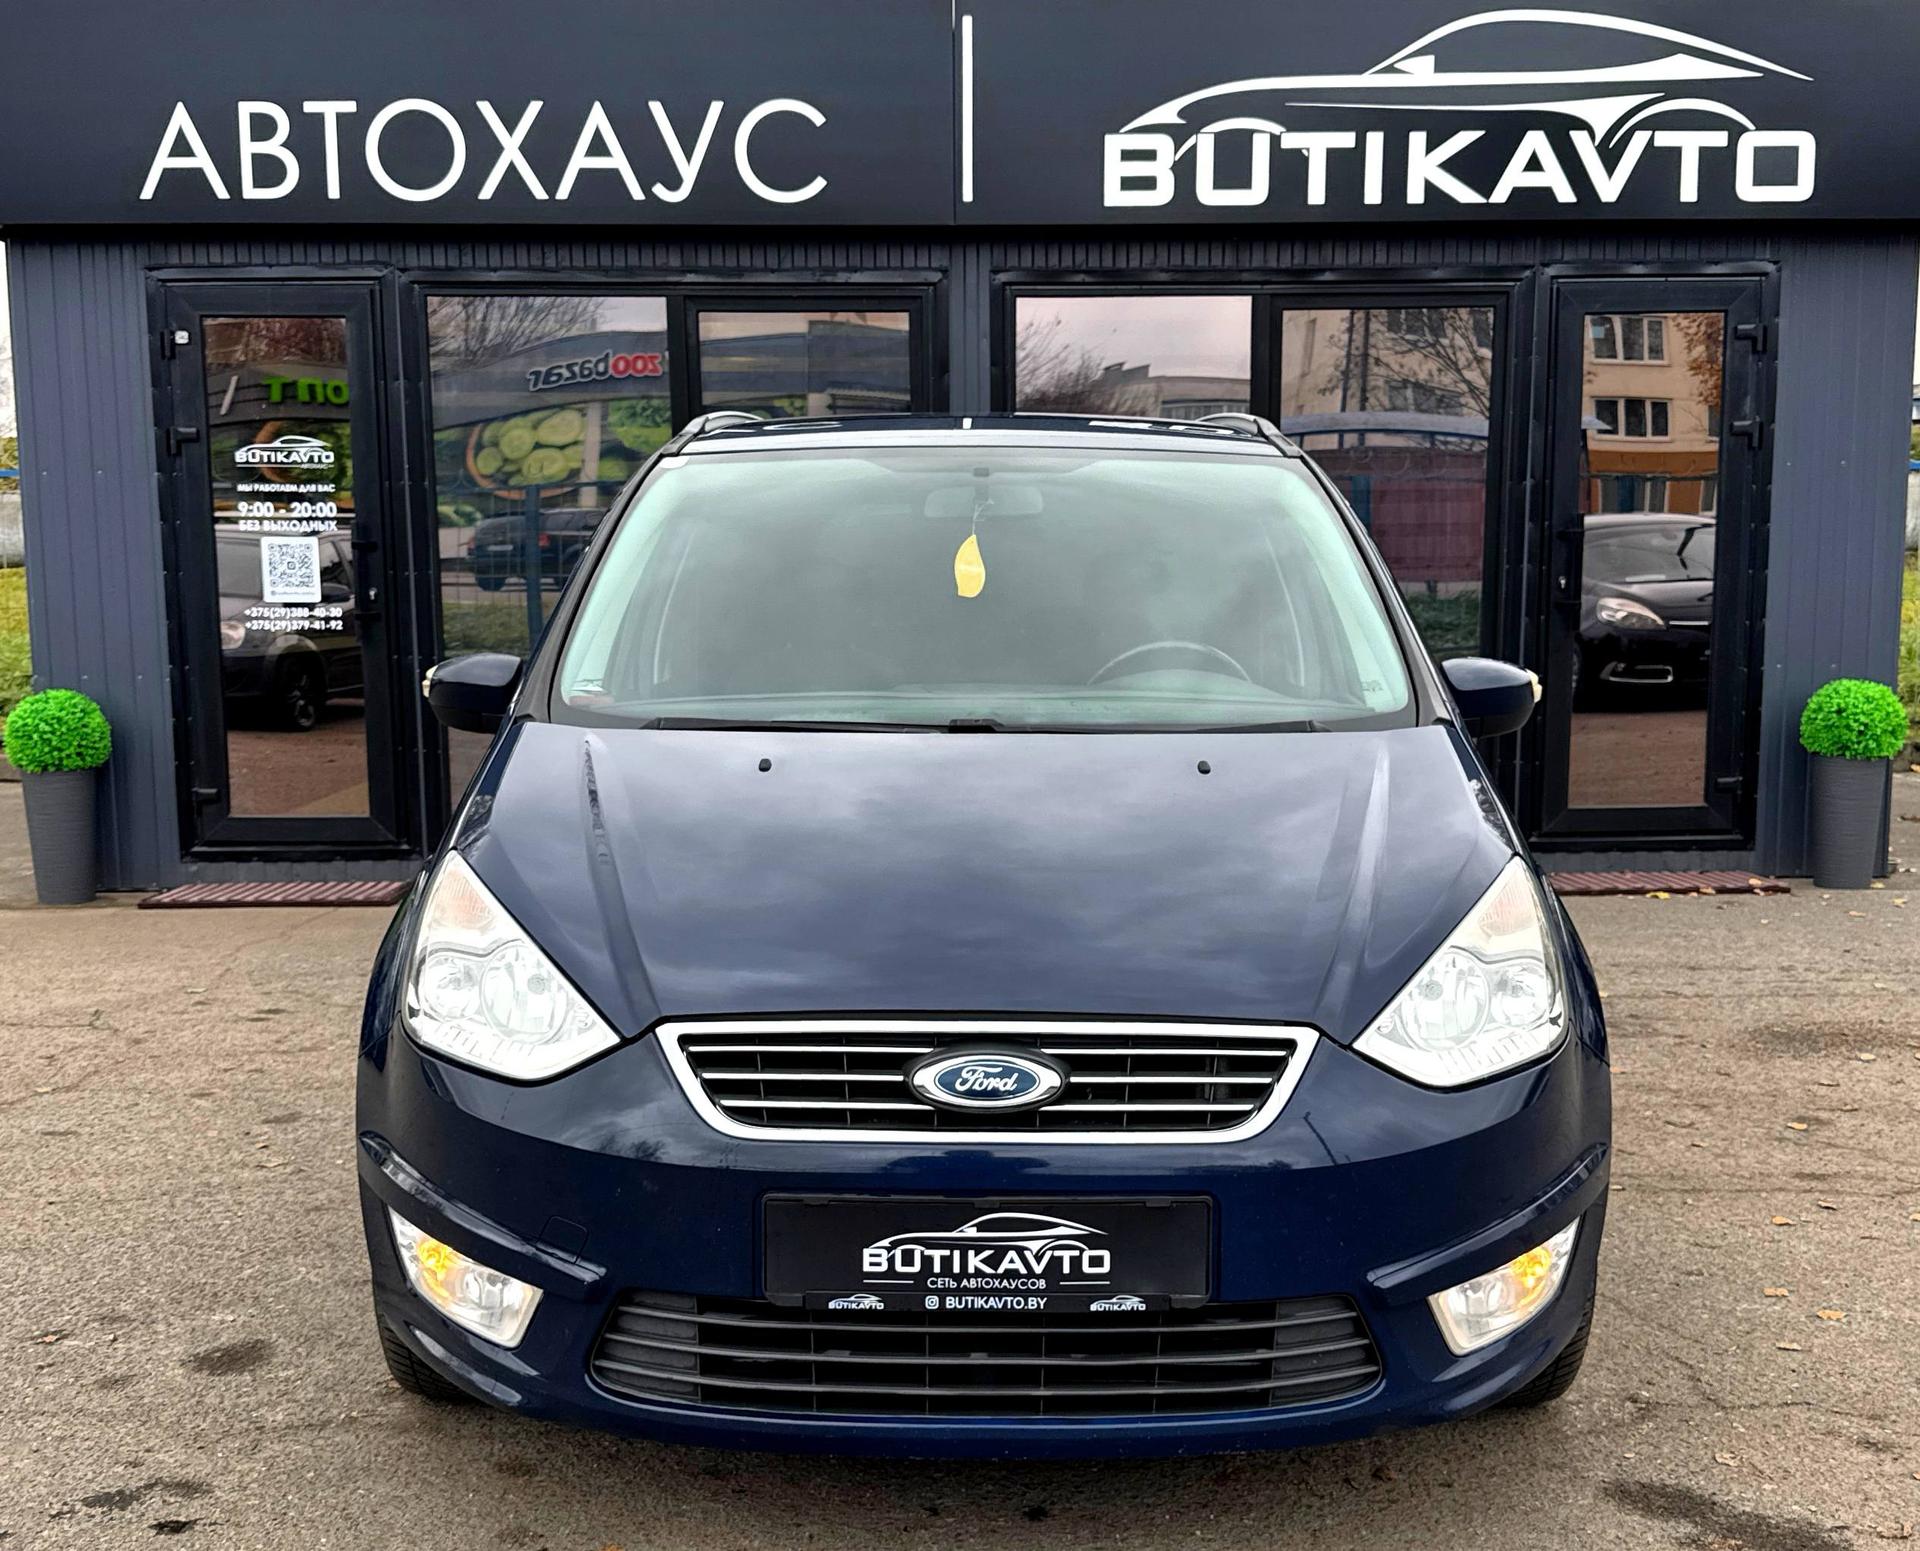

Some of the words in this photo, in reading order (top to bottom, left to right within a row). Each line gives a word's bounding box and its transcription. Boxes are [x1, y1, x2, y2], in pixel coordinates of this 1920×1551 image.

[139, 98, 829, 203] АВТОХАУС
[1103, 130, 1817, 207] BUTIKAVTO
[234, 451, 335, 463] BUTIKAVTO
[253, 484, 298, 492] РАБОТАЕМ
[317, 484, 336, 493] ВАС
[237, 501, 275, 518] 9:00
[289, 501, 338, 518] 20:00
[239, 520, 260, 532] БЕЗ
[262, 520, 338, 533] ВЫХОДНЫХ
[954, 1065, 1019, 1092] Ford
[862, 1248, 1111, 1274] BUTIKAVTO
[926, 1277, 957, 1289] СЕТЬ
[960, 1277, 1047, 1290] АВТОХАУСОВ
[828, 1301, 885, 1310] BUTIKAVTO
[945, 1296, 1048, 1310] BUTIKAVTO.BY
[1089, 1303, 1147, 1311] BUTIKAVTO
